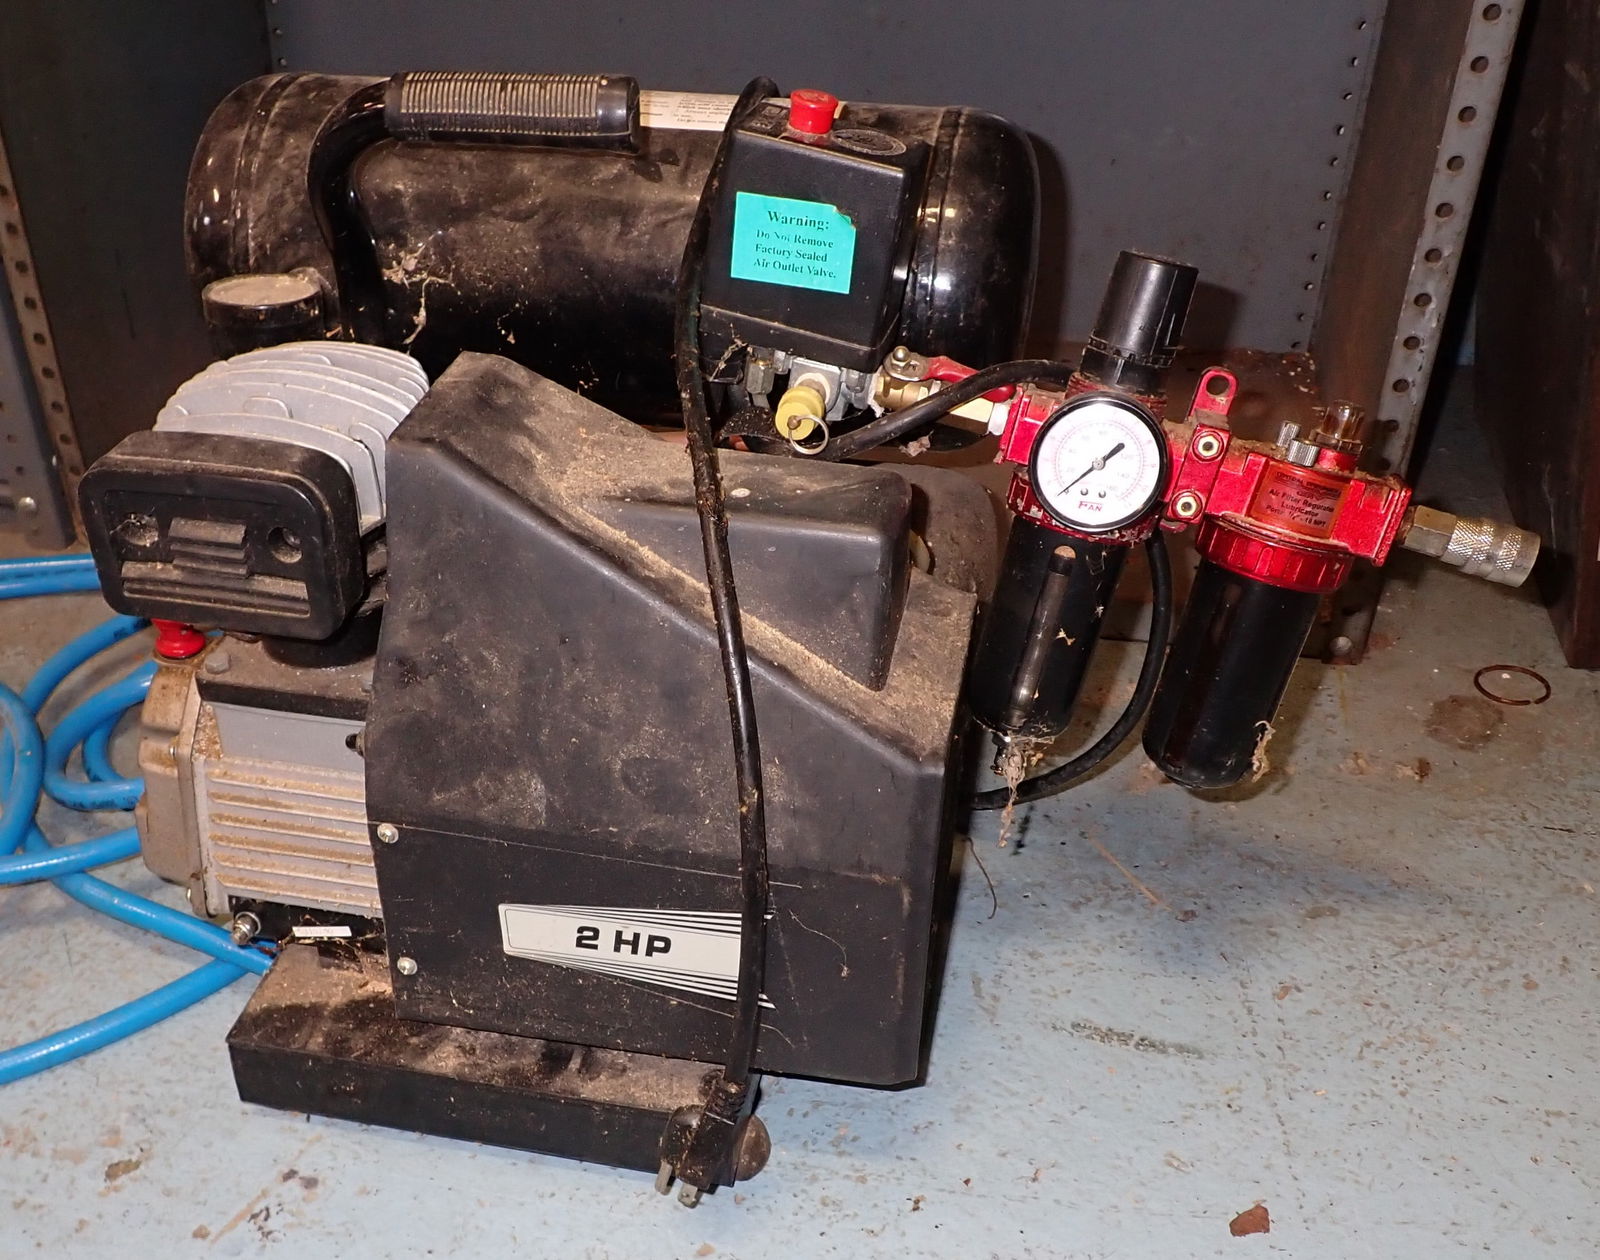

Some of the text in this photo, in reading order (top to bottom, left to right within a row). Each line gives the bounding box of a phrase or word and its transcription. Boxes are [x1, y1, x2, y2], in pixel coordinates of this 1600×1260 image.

[767, 210, 830, 232] Warning:
[756, 229, 770, 240] Do
[794, 234, 834, 249] Remove
[755, 243, 828, 262] Factory Sealed
[753, 258, 837, 279] Air Outlet Valve.
[1269, 488, 1281, 497] Air
[1281, 491, 1301, 504] Filter
[1281, 501, 1319, 517] Lubricator
[575, 925, 672, 957] 2 HP
